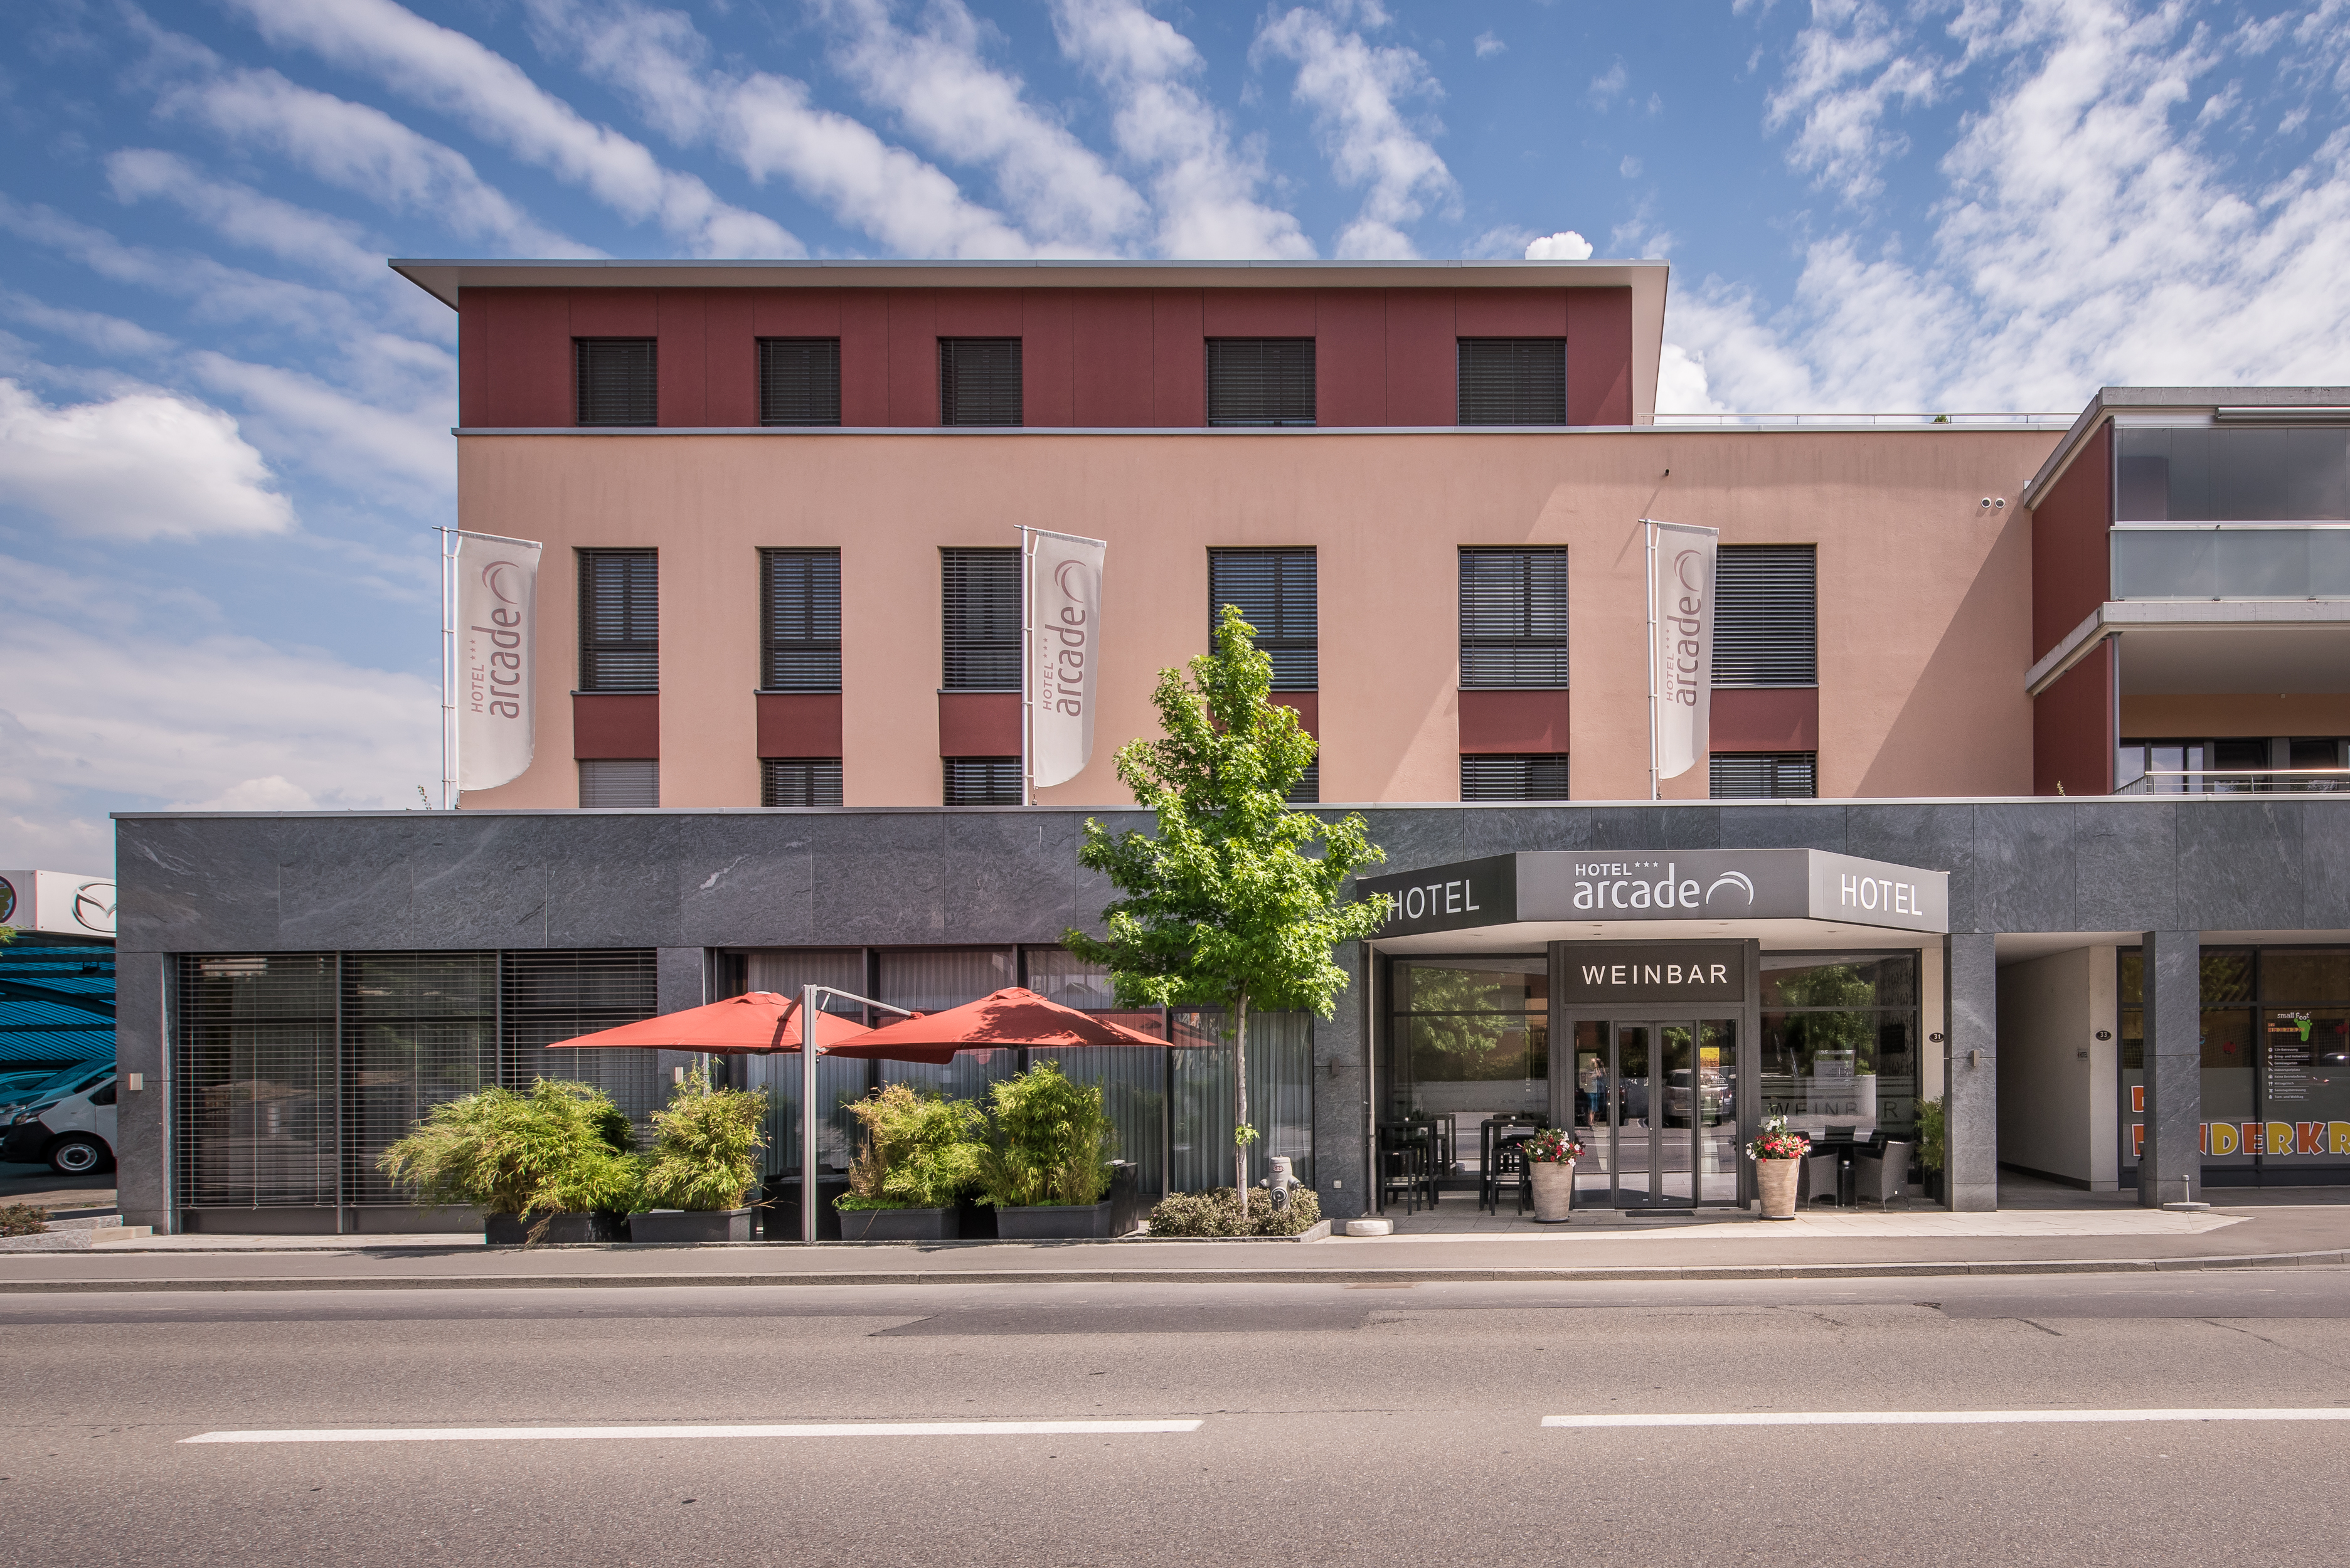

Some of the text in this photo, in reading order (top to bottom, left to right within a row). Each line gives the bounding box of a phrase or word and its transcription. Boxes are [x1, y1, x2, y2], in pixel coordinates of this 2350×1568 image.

[471, 608, 521, 719] arcade
[1045, 606, 1086, 717] arcade
[1667, 596, 1701, 707] arcade
[471, 664, 484, 713] HOTEL
[1043, 662, 1054, 711] HOTEL
[1666, 653, 1675, 702] HOTEL
[1573, 862, 1701, 909] arcade
[1575, 863, 1632, 876] HOTEL
[1387, 879, 1480, 922] HOTEL
[1841, 873, 1923, 916] HOTEL
[1582, 965, 1728, 985] WEINBAR
[1768, 1100, 1898, 1119] WEINBR
